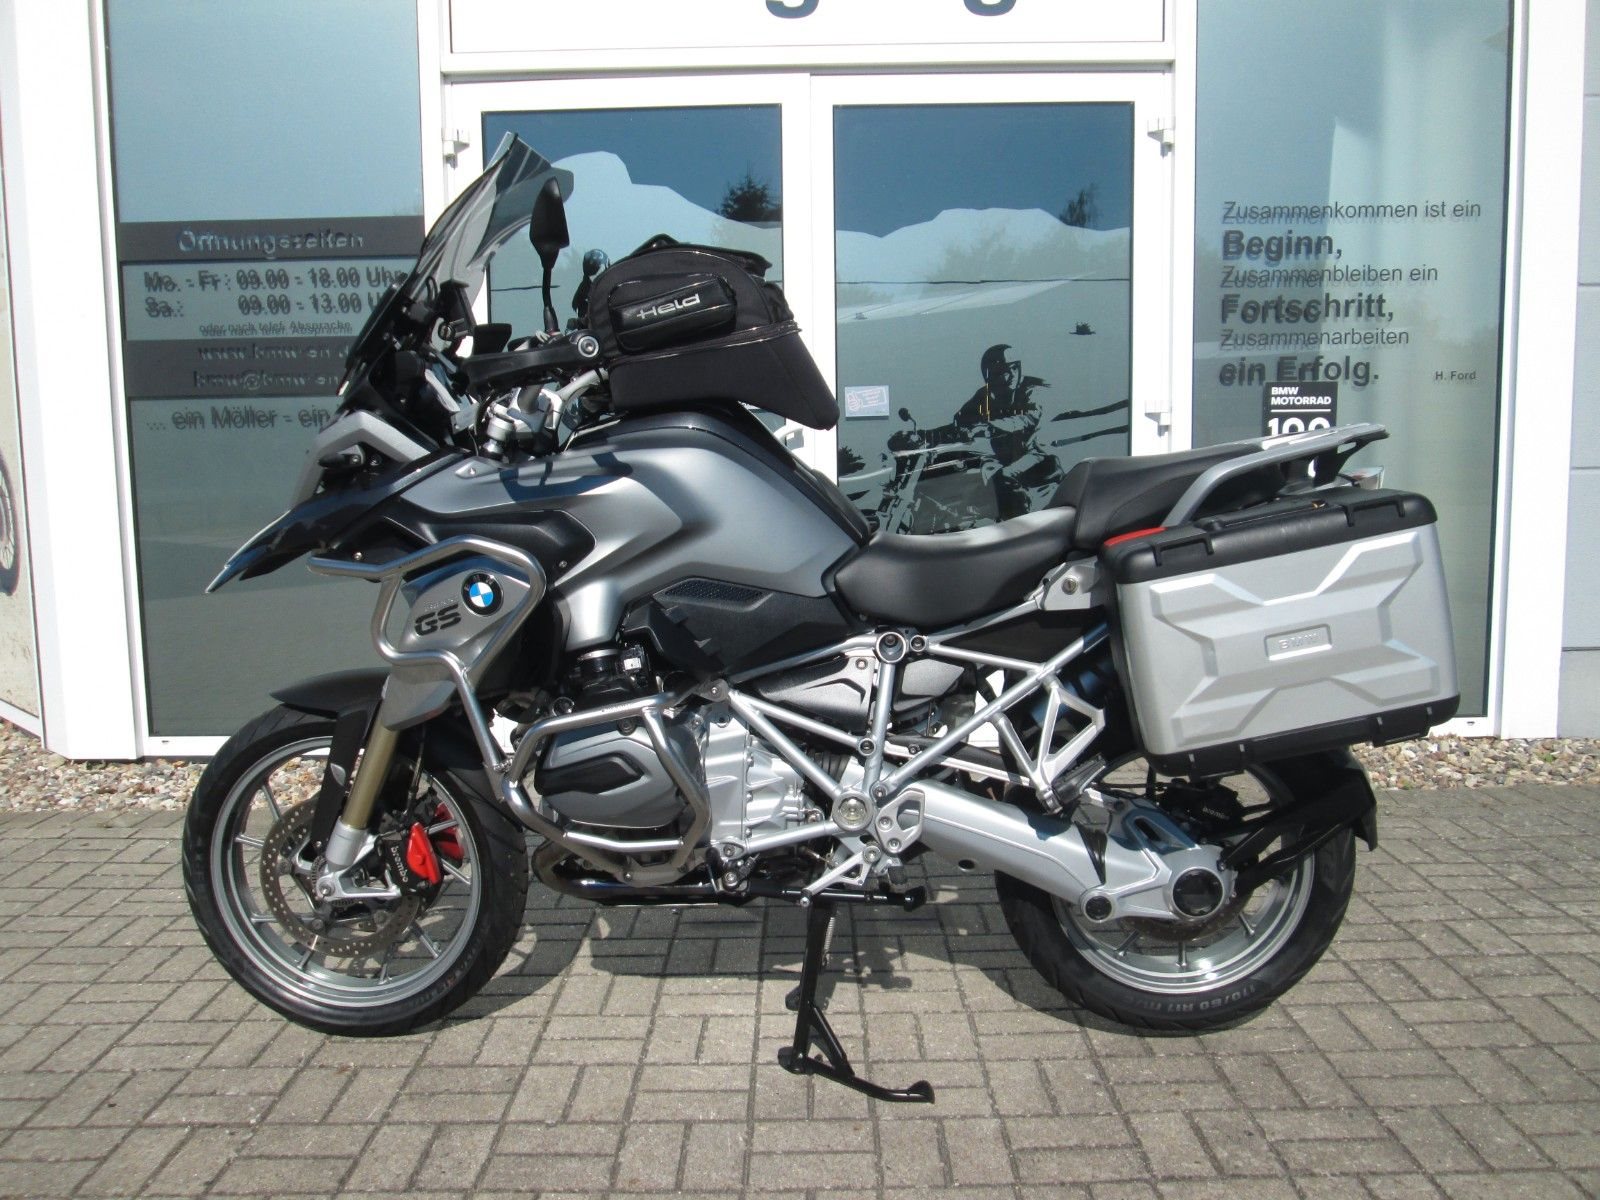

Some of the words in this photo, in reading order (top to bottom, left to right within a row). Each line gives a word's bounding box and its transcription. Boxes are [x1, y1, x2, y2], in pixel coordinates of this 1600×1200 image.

[1222, 201, 1418, 221] Zusammenkommen
[1425, 201, 1447, 218] ist
[1452, 201, 1482, 218] ein
[1222, 229, 1343, 262] Beginn,
[1220, 265, 1402, 285] Zusammenbleiben
[1409, 264, 1439, 281] ein
[636, 293, 701, 320] Held
[1220, 292, 1395, 323] Fortschritt,
[1220, 328, 1409, 348] Zusammenarbeiten
[1218, 358, 1266, 385] ein
[1276, 355, 1380, 387] Erfolg.
[1435, 371, 1447, 381] H.
[1450, 370, 1477, 381] Ford
[1270, 396, 1332, 406] MOTORRAD
[1271, 386, 1299, 395] BMW
[210, 405, 278, 429] Möller
[414, 603, 462, 636] GS
[390, 845, 409, 883] brembo
